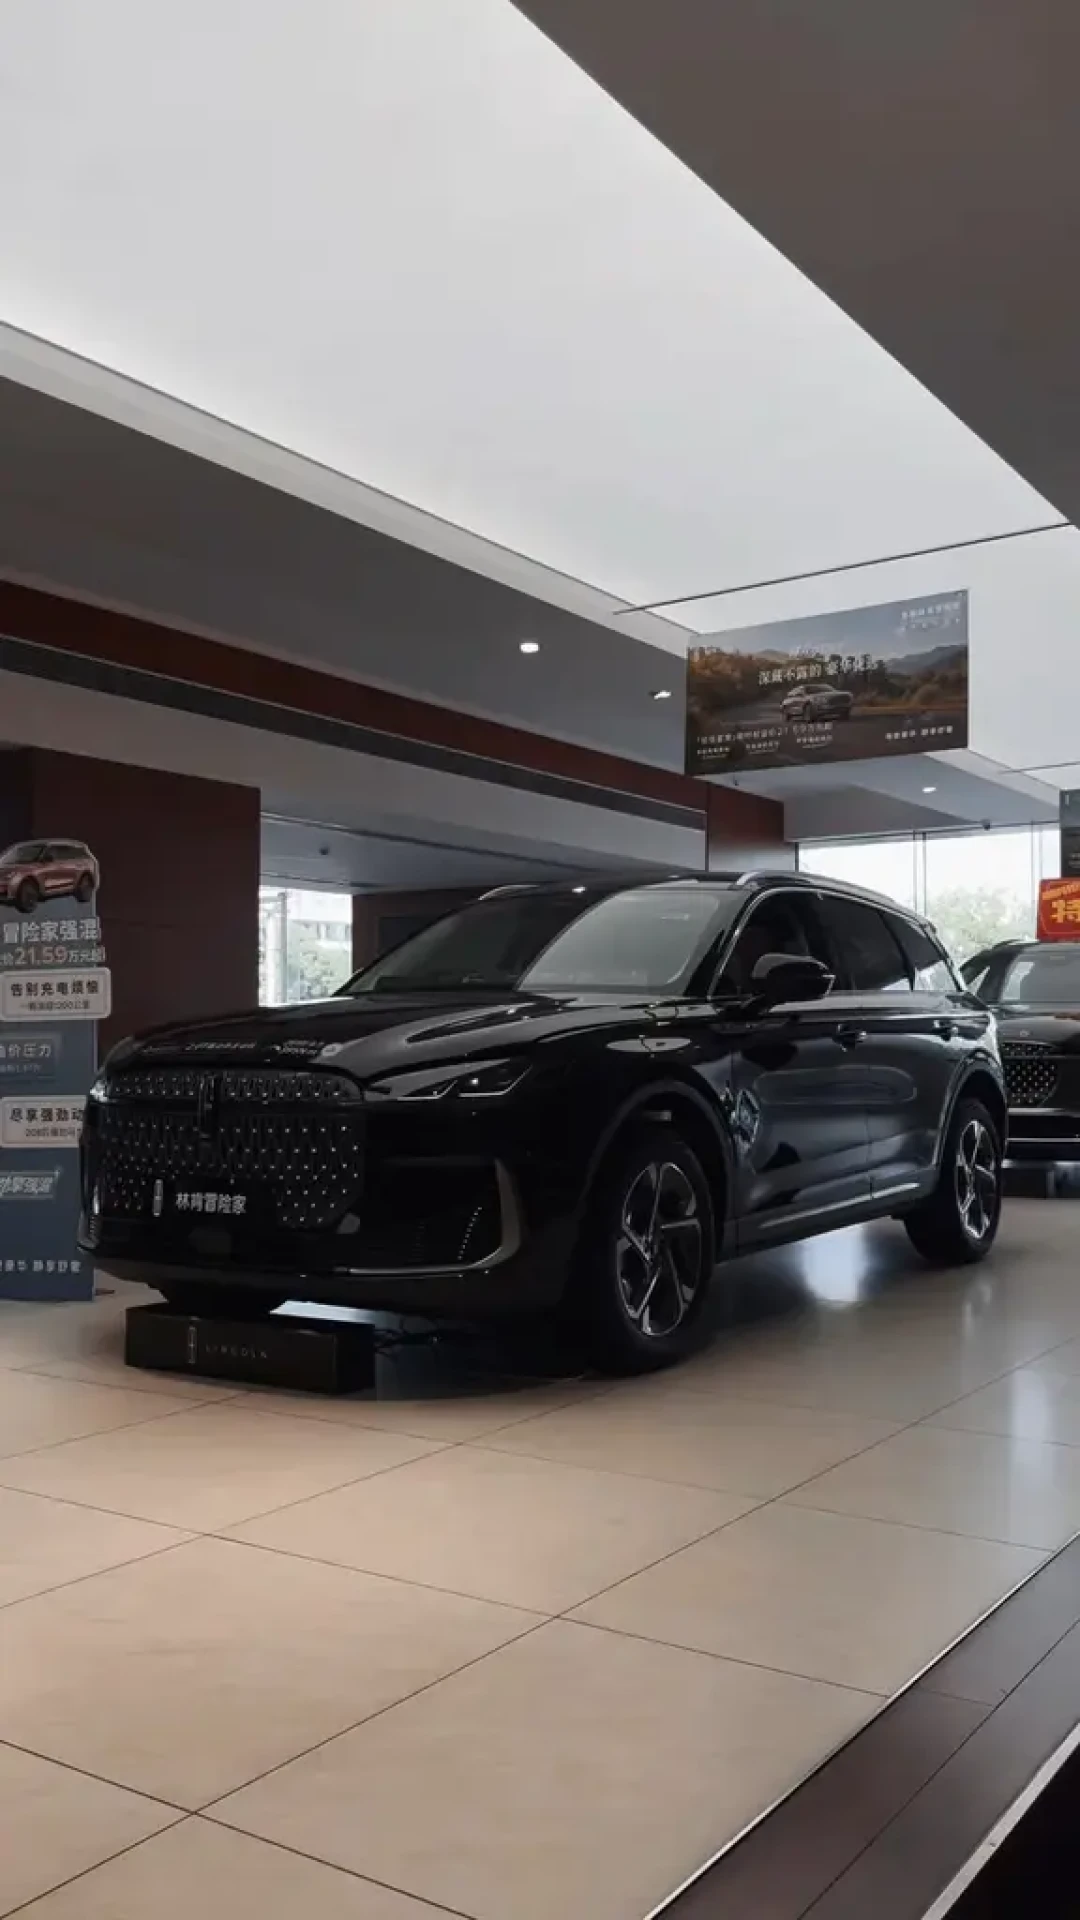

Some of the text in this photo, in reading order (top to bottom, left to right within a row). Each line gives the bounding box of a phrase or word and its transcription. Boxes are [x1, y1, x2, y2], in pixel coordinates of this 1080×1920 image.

[3, 917, 100, 943] 冒险家强混
[0, 945, 104, 966] 价21.59万元起
[10, 979, 99, 997] 告别充电烦恼
[175, 1192, 247, 1215] 林肯冒险家
[205, 1343, 268, 1359] LINCOLN
